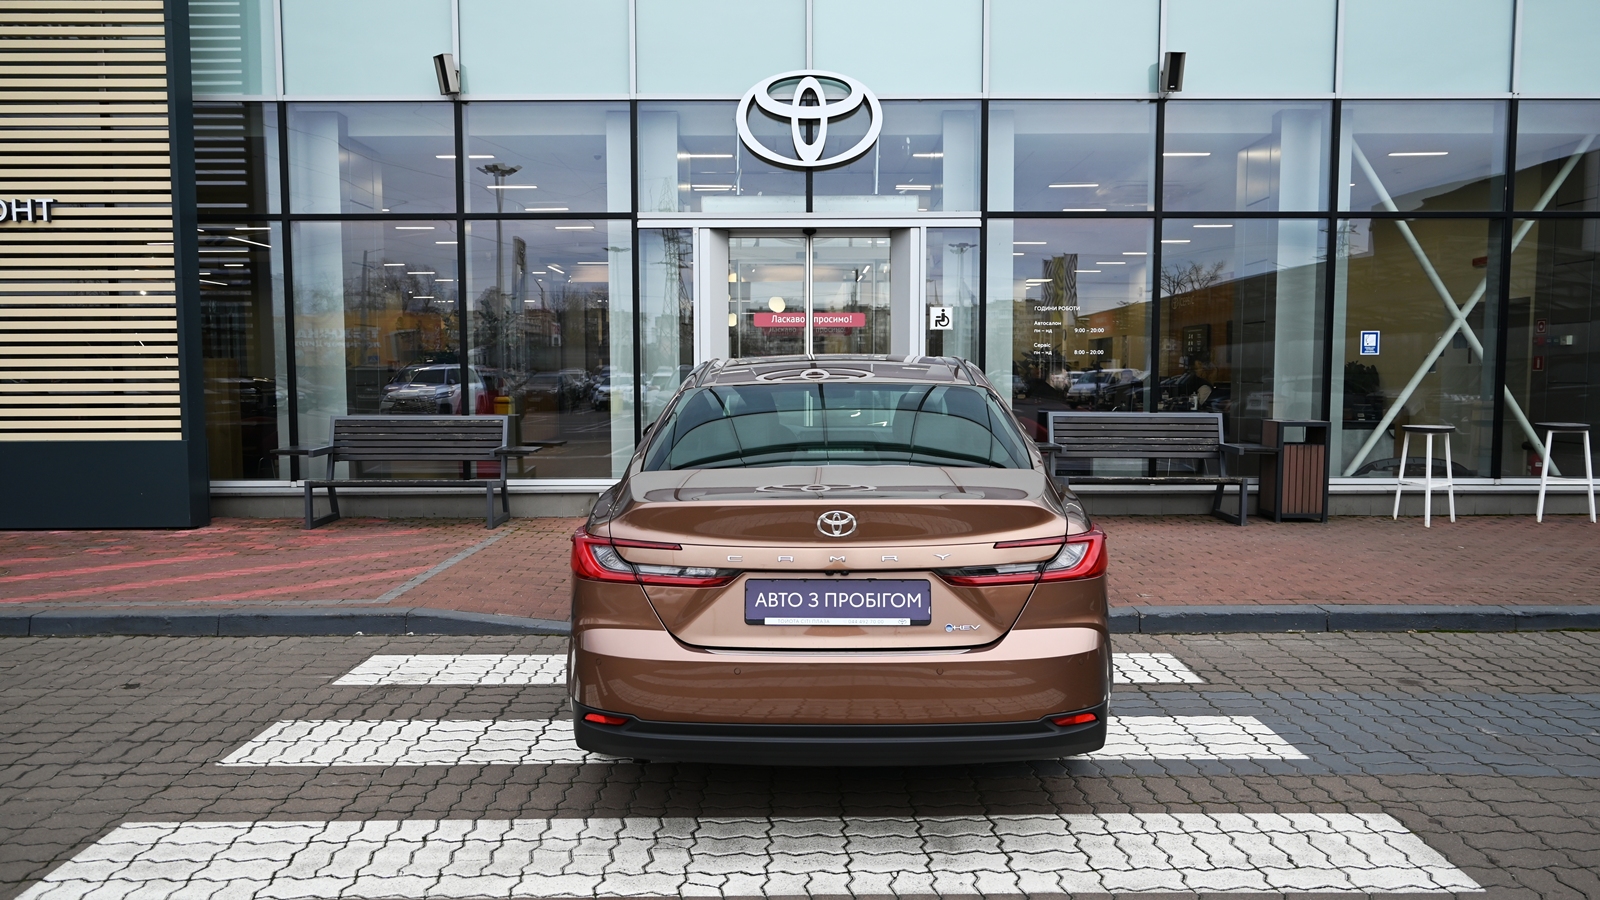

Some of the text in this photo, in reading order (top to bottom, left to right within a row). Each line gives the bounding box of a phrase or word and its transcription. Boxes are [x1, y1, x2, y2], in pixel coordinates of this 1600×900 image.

[771, 315, 853, 325] Ласкаво просимо!
[727, 553, 951, 563] CAMRY
[755, 593, 922, 608] АВТО З ПРОБІГОМ
